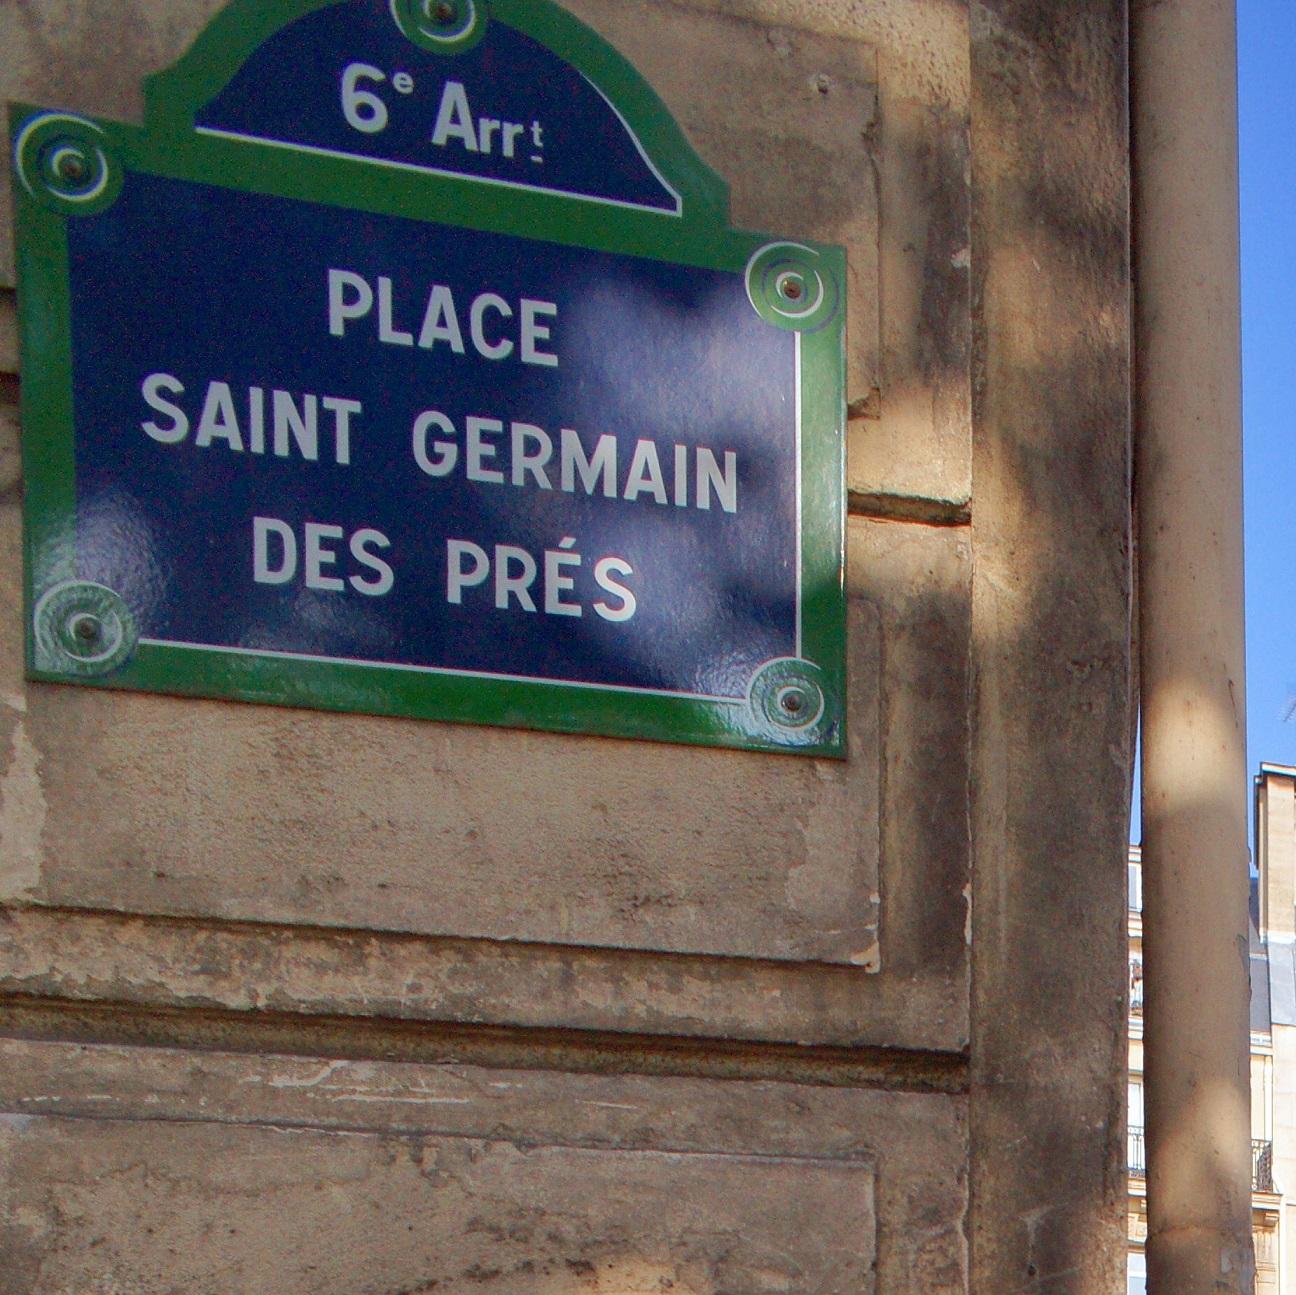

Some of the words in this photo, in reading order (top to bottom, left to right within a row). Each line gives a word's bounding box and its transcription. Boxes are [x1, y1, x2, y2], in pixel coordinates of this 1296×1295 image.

[327, 268, 560, 368] PLACE
[140, 372, 362, 466] SAINT
[411, 410, 739, 515] GERMAIN
[251, 517, 395, 597] DES
[446, 537, 638, 624] PRÉS
